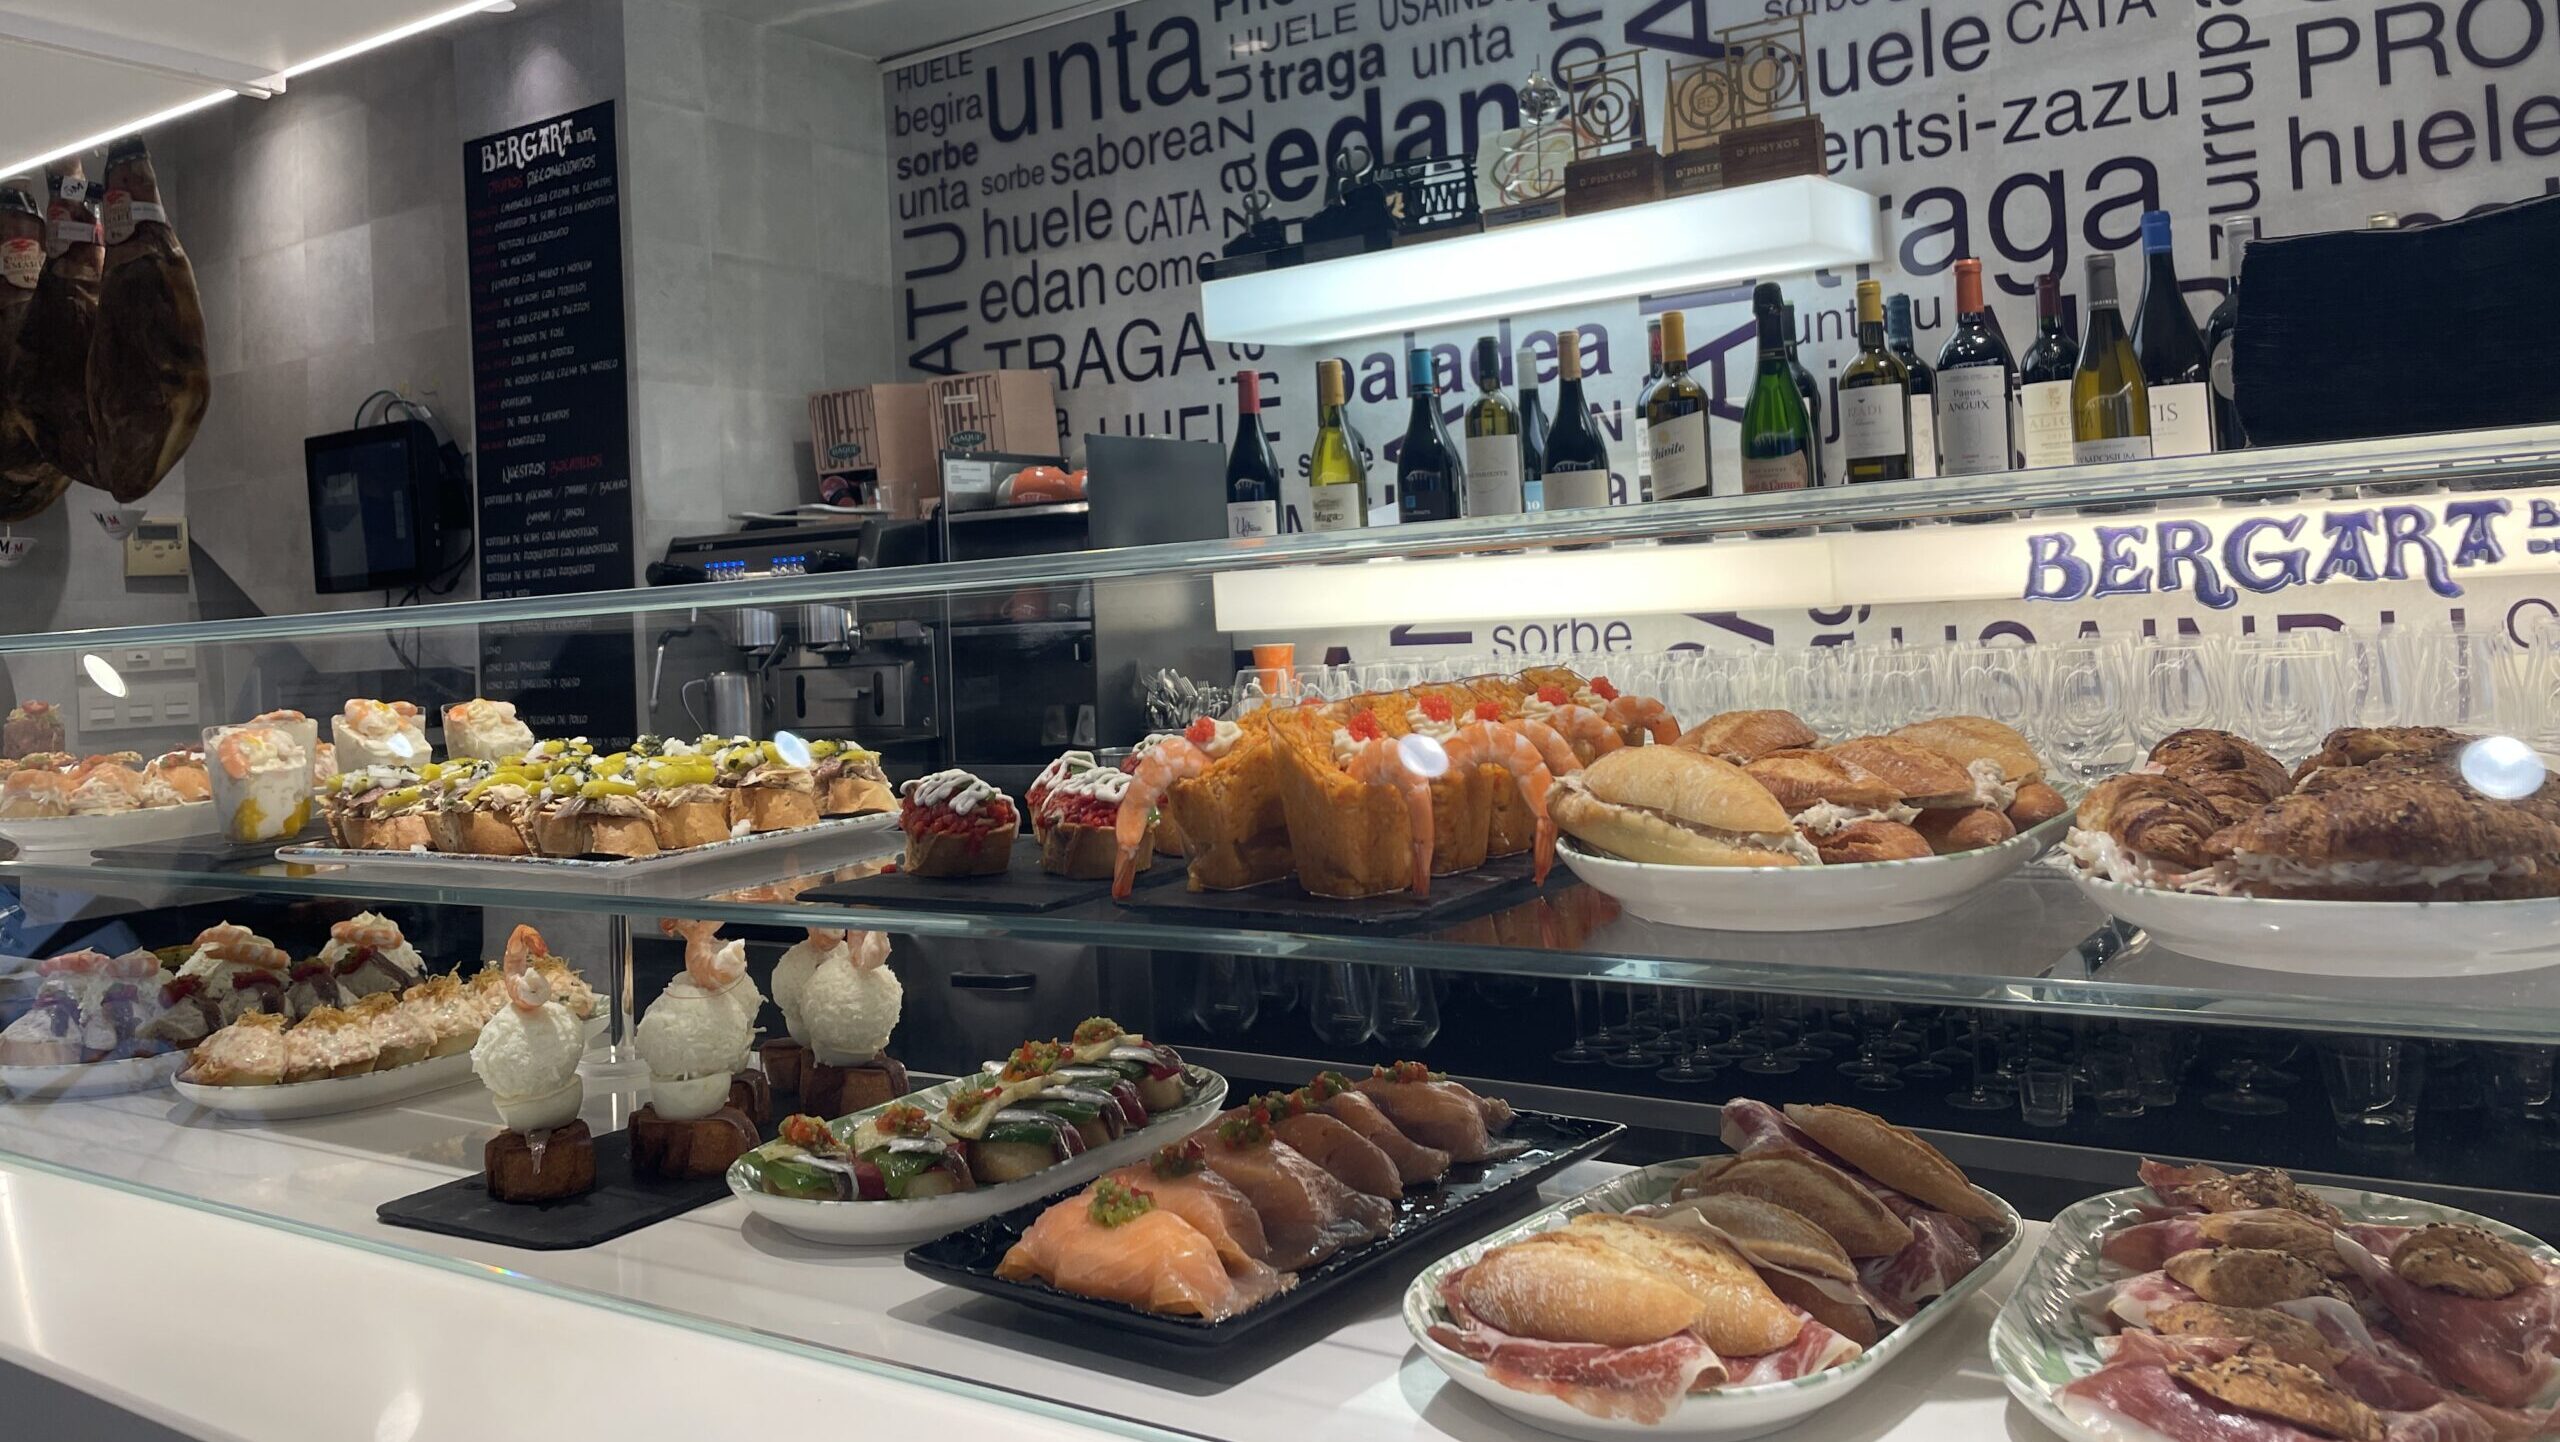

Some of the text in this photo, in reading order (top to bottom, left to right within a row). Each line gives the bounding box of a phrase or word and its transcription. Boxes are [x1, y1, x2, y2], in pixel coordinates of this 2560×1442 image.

[1229, 2, 1358, 62] HUELE
[1411, 23, 1514, 80] unta
[2295, 0, 2560, 100] PRO
[896, 50, 974, 92] HUELE
[986, 10, 1210, 143] unta
[1259, 41, 1387, 102] traga
[895, 91, 984, 137] begira
[2288, 83, 2560, 191] huele
[481, 118, 574, 174] BERGARA
[896, 140, 979, 181] sorbe
[1050, 119, 1214, 185] saborea
[1264, 87, 1520, 204] edan
[1675, 162, 1722, 180] D'PINTX
[898, 176, 971, 221] unta
[981, 163, 1046, 197] sorbe
[982, 189, 1113, 259] huele
[1124, 188, 1211, 246] CATA
[1813, 153, 2162, 297] aga
[979, 258, 1106, 324] edan
[983, 311, 1217, 391] TRAGA
[1947, 400, 1990, 413] ANGUIX
[2023, 498, 2512, 610] BERGARA
[1492, 617, 1634, 656] sorbe
